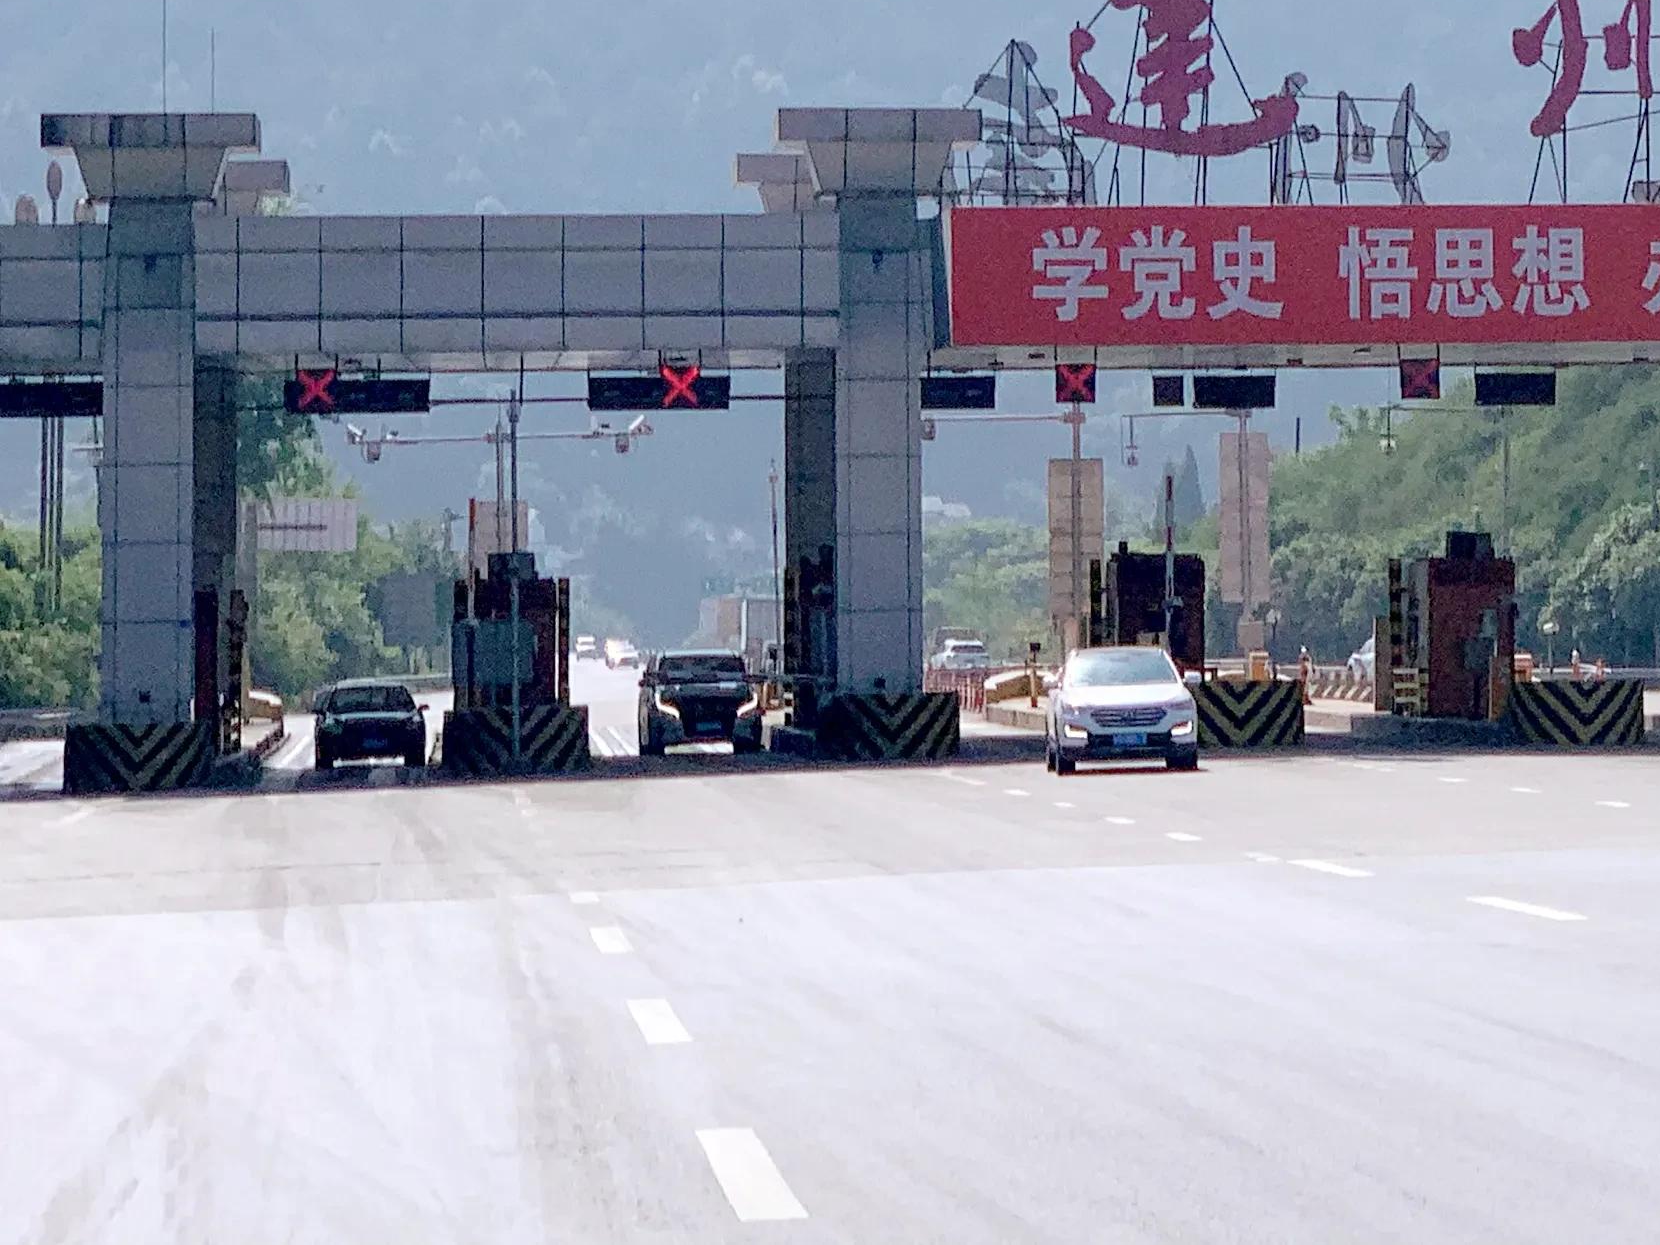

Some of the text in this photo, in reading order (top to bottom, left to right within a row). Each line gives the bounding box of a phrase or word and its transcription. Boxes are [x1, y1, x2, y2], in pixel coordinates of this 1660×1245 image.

[1032, 225, 1284, 322] 学党史
[1338, 224, 1592, 321] 悟思想
